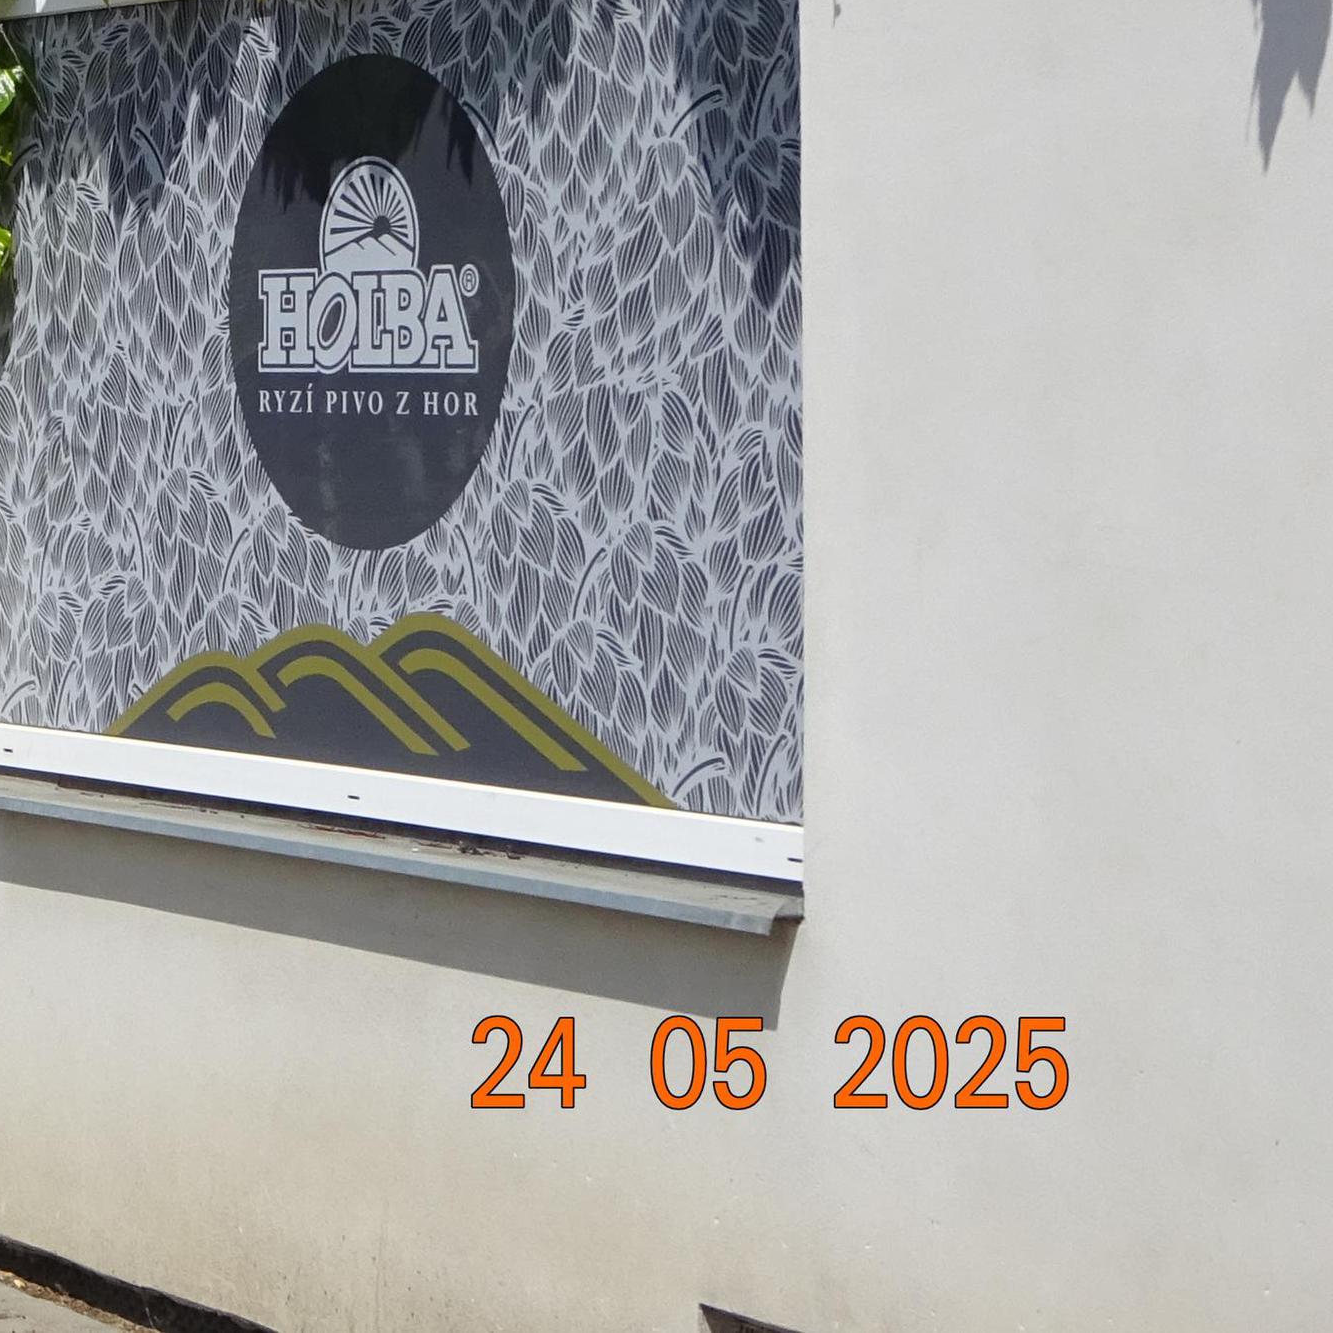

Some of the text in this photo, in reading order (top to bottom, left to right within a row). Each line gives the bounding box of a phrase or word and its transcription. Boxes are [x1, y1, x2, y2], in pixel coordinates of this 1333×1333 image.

[258, 383, 479, 416] RYZÍ PIVO Z HOR
